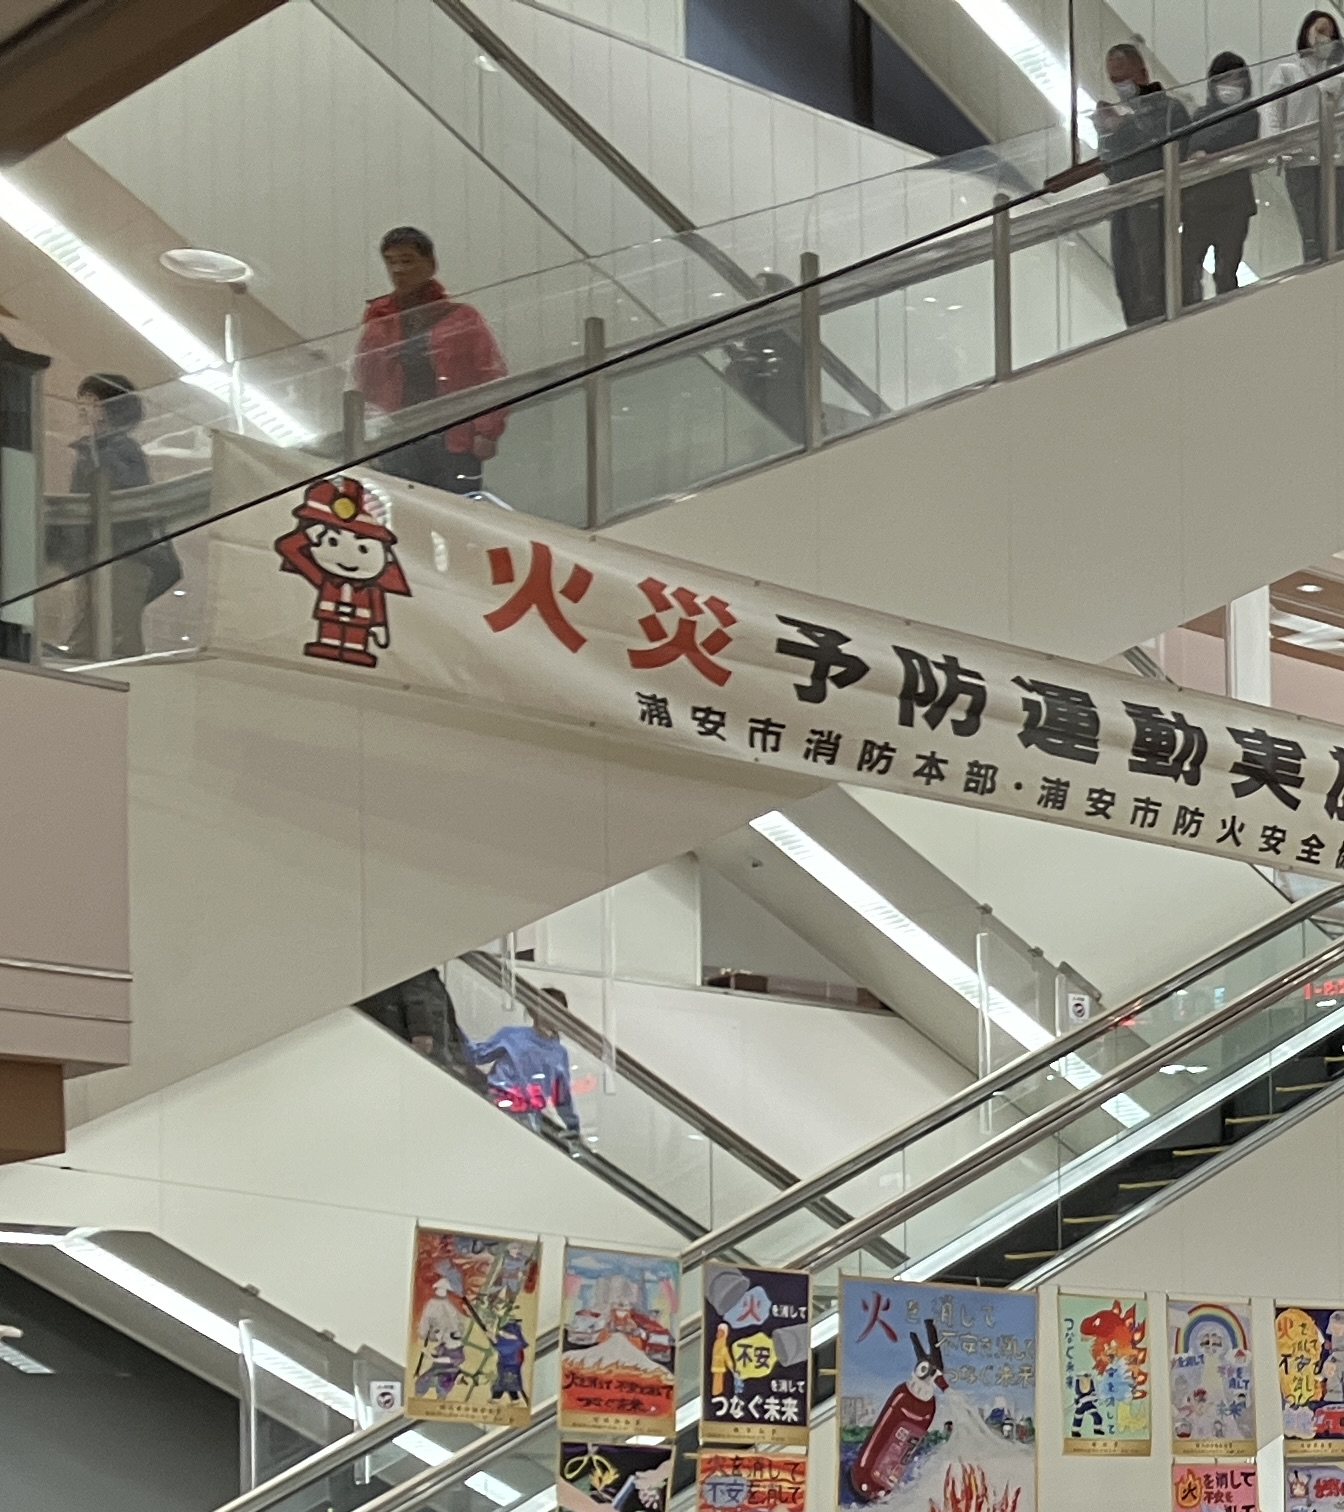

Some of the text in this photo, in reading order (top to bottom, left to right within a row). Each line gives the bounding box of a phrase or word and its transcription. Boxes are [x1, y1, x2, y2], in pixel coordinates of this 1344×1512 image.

[736, 1344, 771, 1369] 不安
[711, 1396, 799, 1422] つなぐ未来
